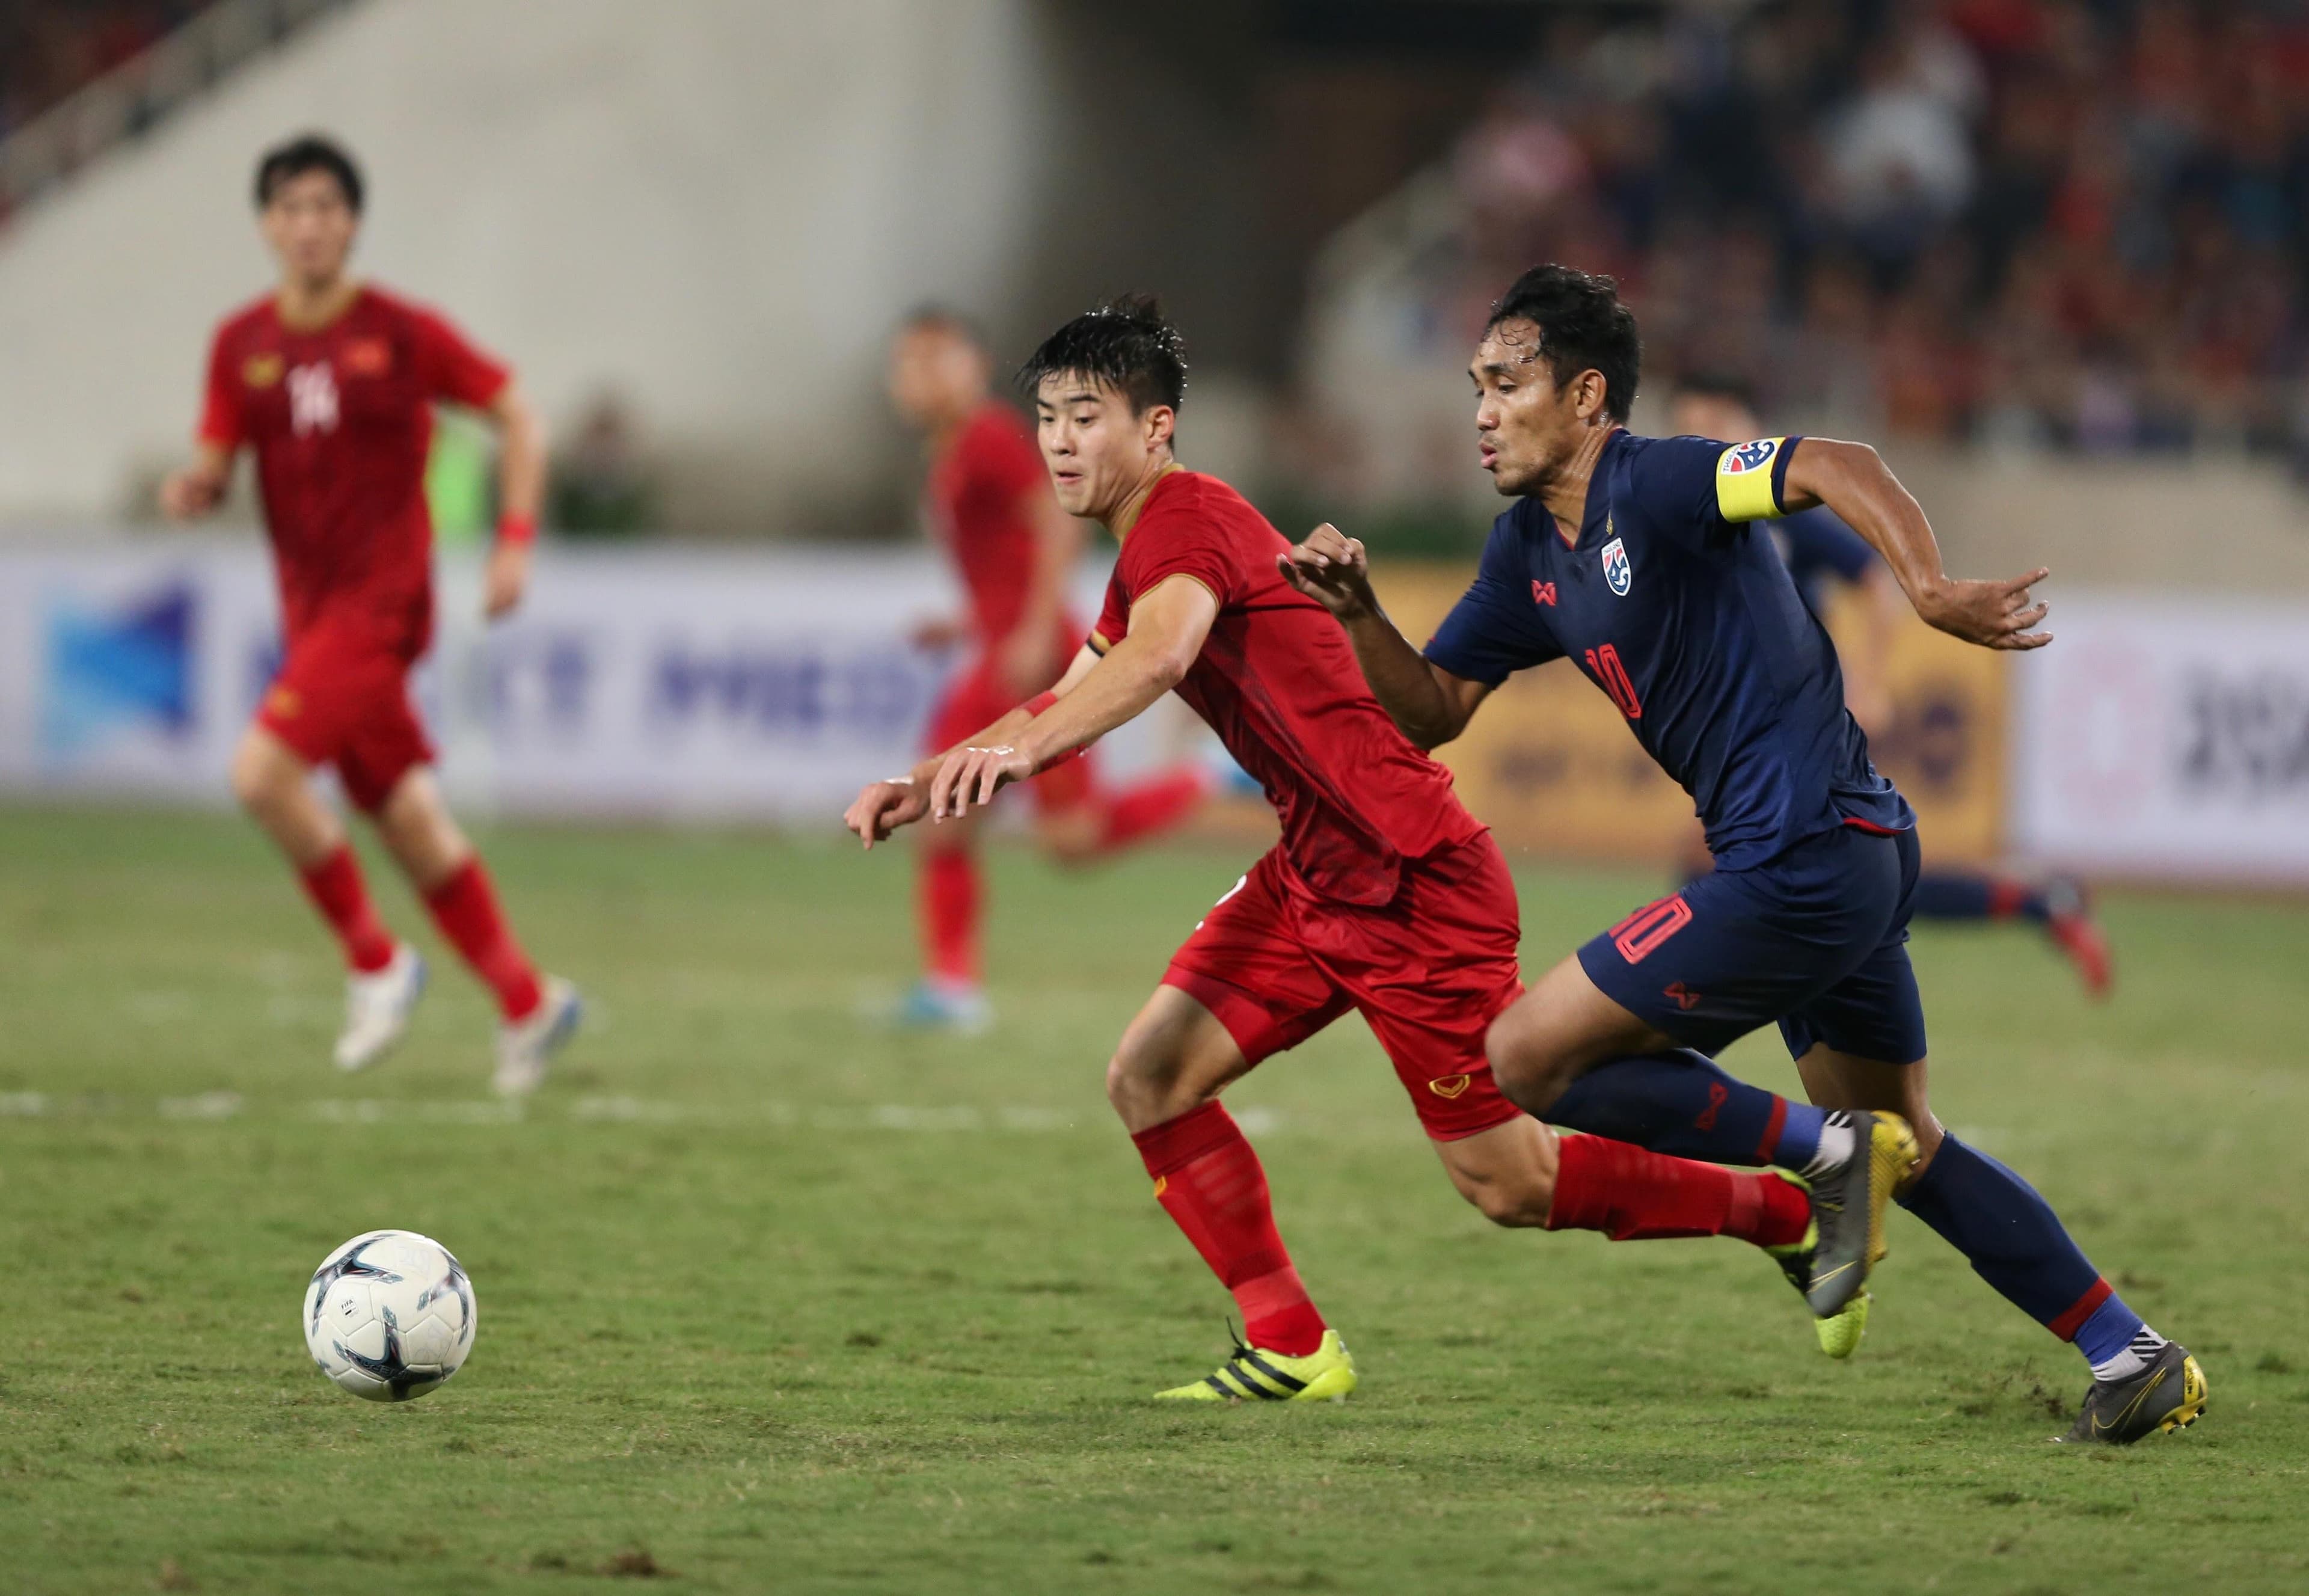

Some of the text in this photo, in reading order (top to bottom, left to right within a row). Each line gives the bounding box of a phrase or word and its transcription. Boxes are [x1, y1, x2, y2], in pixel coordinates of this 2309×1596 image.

[1584, 643, 1642, 719] 10
[1608, 891, 1693, 965] 10
[341, 1299, 354, 1310] FIFA
